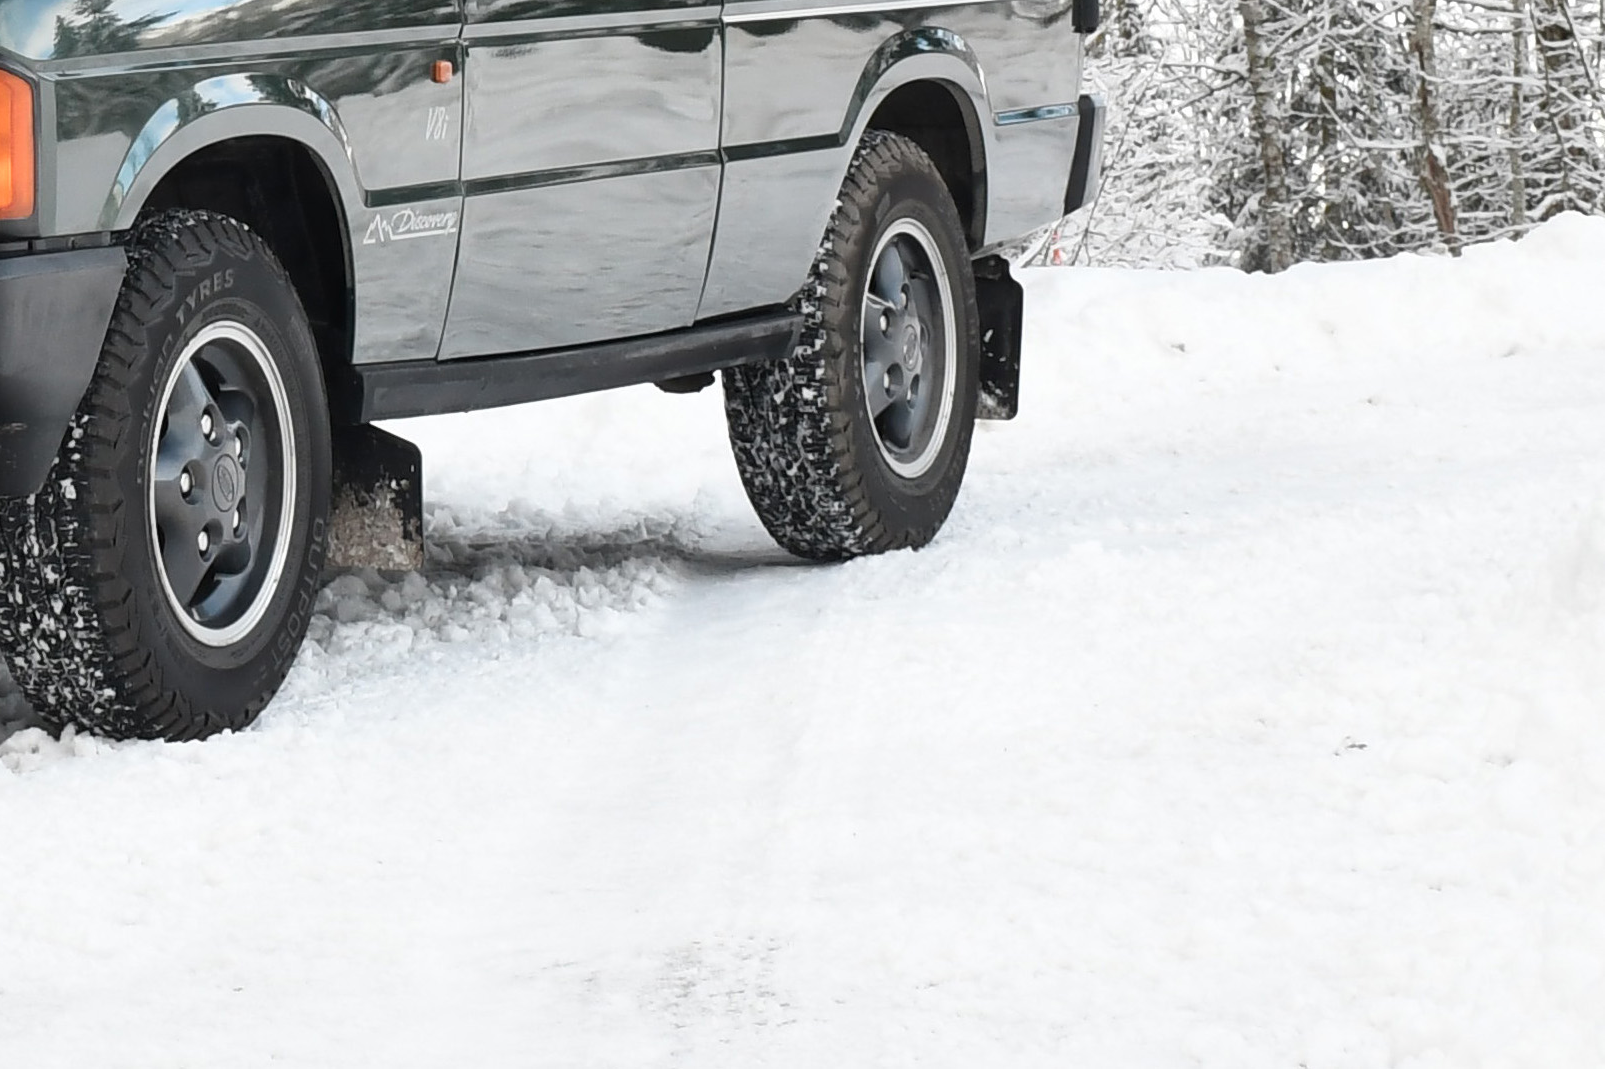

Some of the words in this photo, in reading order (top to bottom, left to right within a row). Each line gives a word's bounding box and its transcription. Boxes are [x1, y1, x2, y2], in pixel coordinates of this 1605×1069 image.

[391, 208, 458, 235] Discovery
[175, 268, 234, 326] TYRES
[270, 517, 326, 672] OUTPOST
